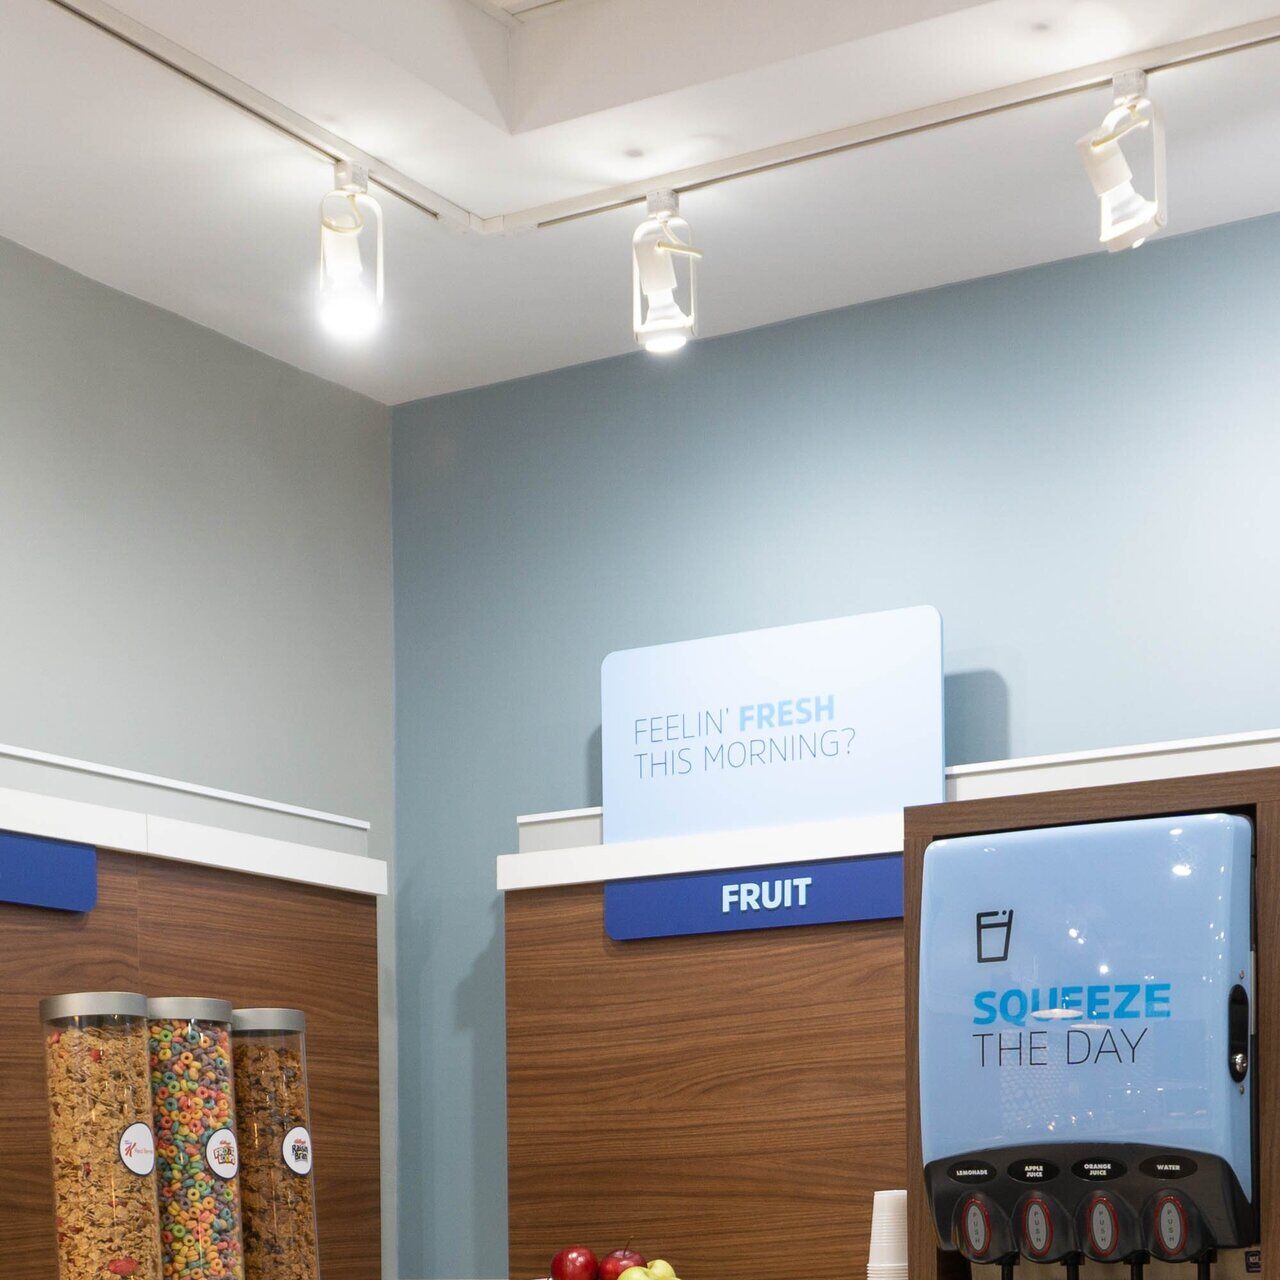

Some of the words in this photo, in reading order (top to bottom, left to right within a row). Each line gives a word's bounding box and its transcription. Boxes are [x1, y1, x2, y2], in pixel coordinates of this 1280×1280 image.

[738, 693, 835, 732] FRESH
[633, 746, 693, 780] THIS
[703, 727, 857, 772] MORNING?
[721, 876, 813, 914] FRUIT
[972, 982, 1172, 1028] SQUEEZE
[972, 1030, 1048, 1068] THE
[1066, 1027, 1149, 1066] DAY
[956, 1169, 988, 1177] LEMONADE
[1083, 1163, 1112, 1171] ORANGE
[1156, 1164, 1181, 1172] WATER
